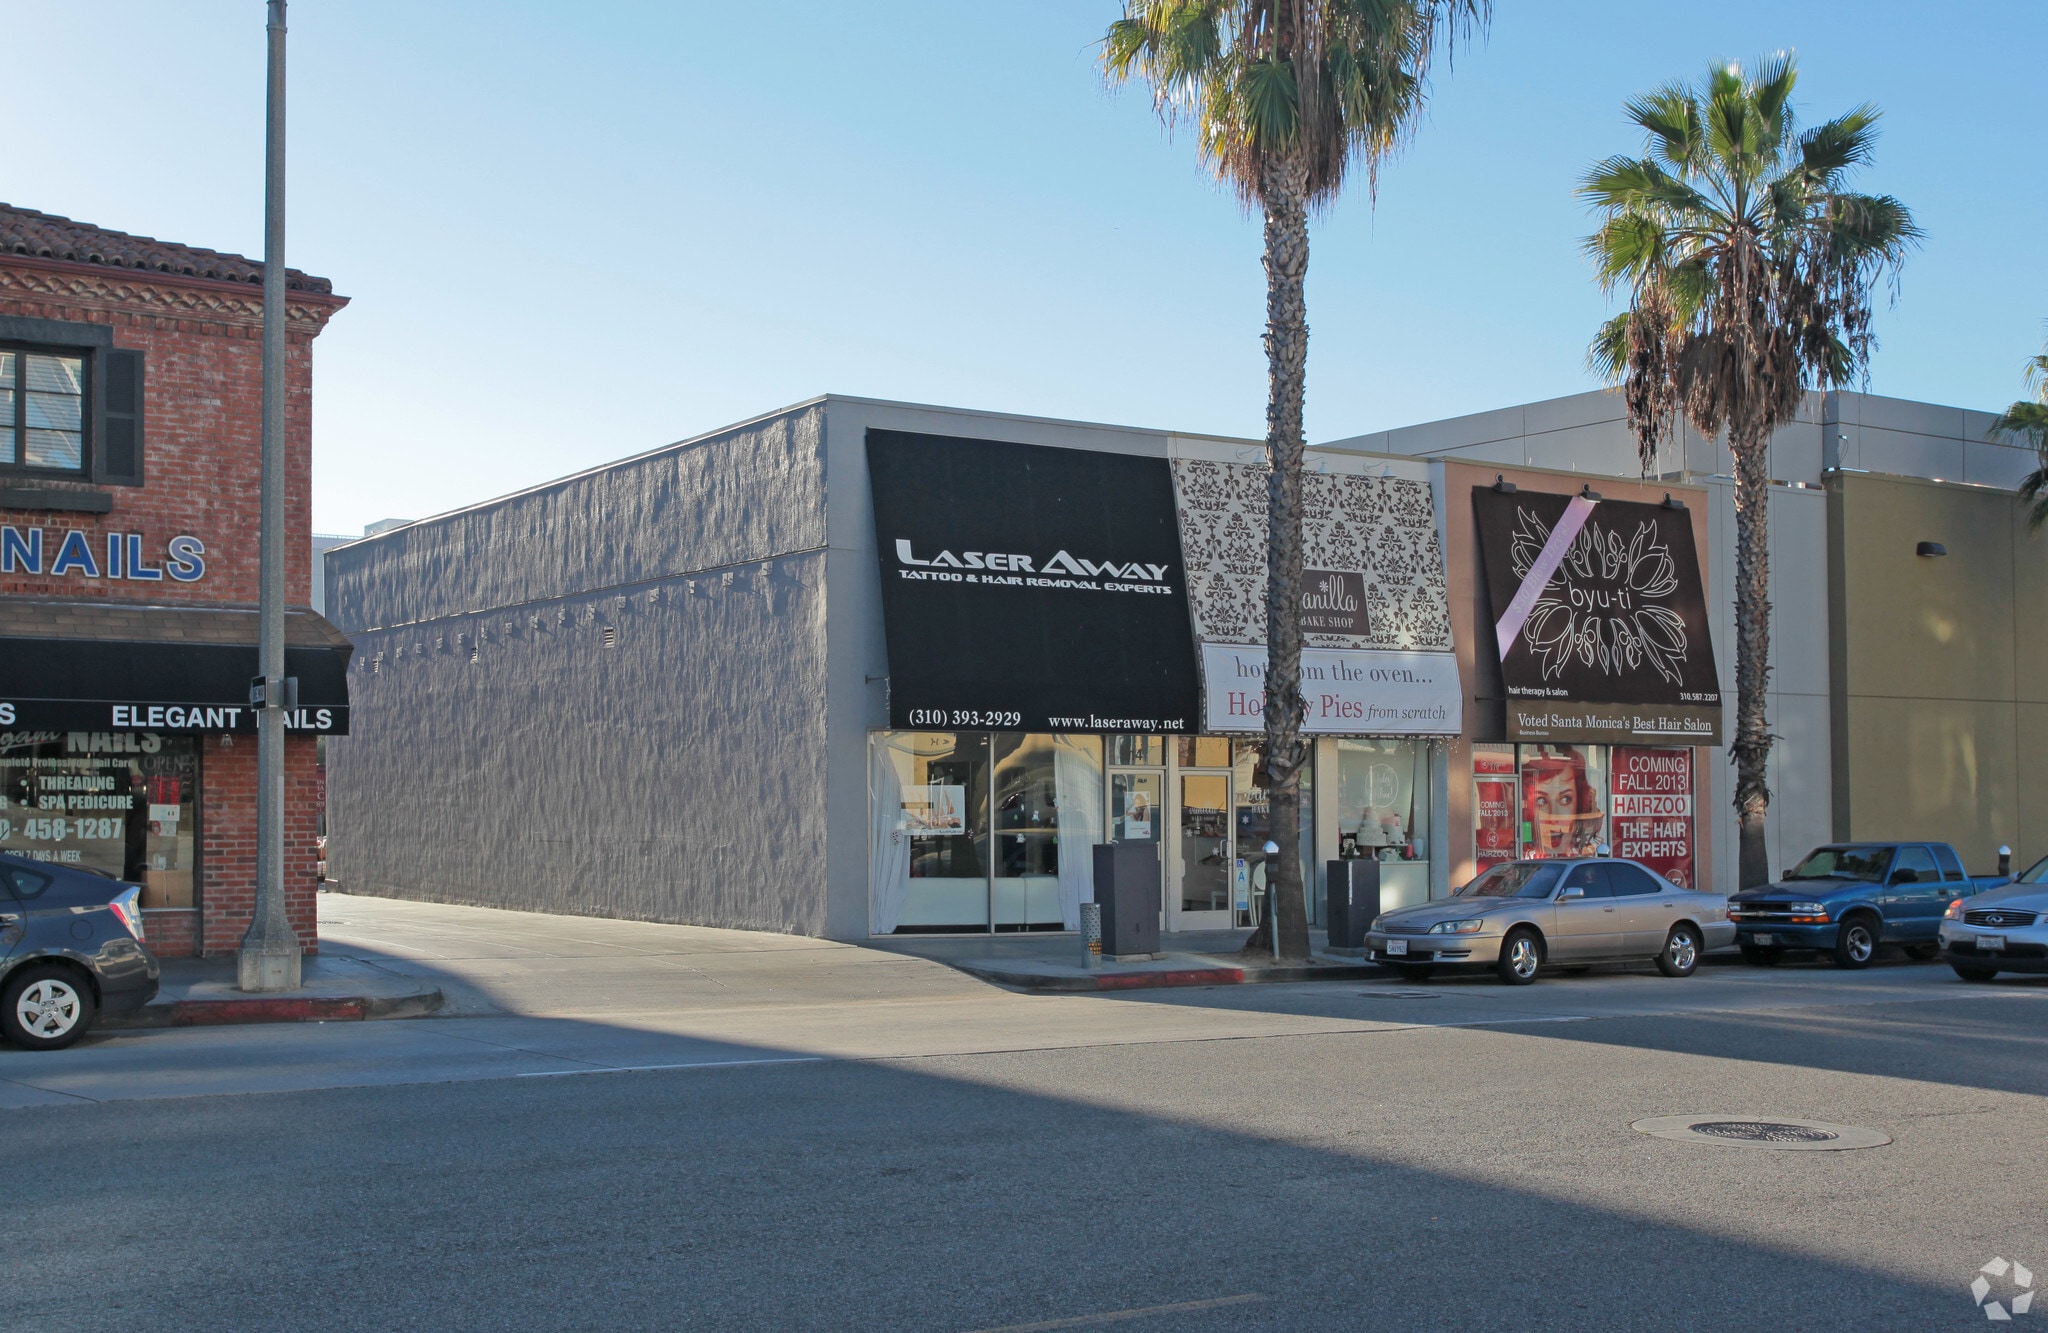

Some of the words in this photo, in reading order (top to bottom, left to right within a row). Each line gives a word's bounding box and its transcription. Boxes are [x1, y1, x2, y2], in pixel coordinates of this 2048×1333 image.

[1, 526, 206, 583] NAILS
[898, 570, 963, 582] TATTOO
[966, 573, 979, 583] &
[982, 575, 1024, 586] HAIR
[1026, 578, 1101, 590] REMOVAL
[1104, 582, 1172, 595] EXPERTS
[1302, 575, 1358, 612] anilla
[1569, 582, 1631, 613] byu-ti
[1328, 617, 1354, 629] SHOP
[1330, 660, 1363, 682] the
[1369, 667, 1433, 684] oven...
[1508, 686, 1521, 695] hair
[1521, 686, 1546, 697] therapy
[1546, 687, 1551, 696] &
[1552, 688, 1569, 697] salon
[1320, 693, 1363, 718] Pies
[1366, 703, 1399, 722] from
[1401, 703, 1446, 720] scratch
[112, 705, 241, 728] ELEGANT
[909, 709, 948, 727] (310)
[952, 710, 1021, 726] 393-2929
[1048, 715, 1185, 731] www.laseraway.net
[1517, 713, 1548, 727] Voted
[1551, 714, 1582, 728] Santa
[1585, 715, 1630, 729] Monica's
[1633, 716, 1655, 730] Best
[1658, 717, 1682, 730] Hair
[1684, 717, 1712, 731] Salon
[67, 732, 162, 753] NAILS
[93, 758, 110, 767] Nail
[1629, 756, 1685, 773] COMING
[40, 776, 115, 790] THREADING
[1619, 774, 1652, 790] FALL
[1655, 775, 1686, 790] 2013
[39, 796, 65, 809] SPA
[68, 796, 133, 809] PEDICURE
[1614, 797, 1686, 814] HAIRZOO
[24, 818, 122, 839] 458-1287
[1620, 822, 1649, 838] THE
[1653, 822, 1686, 838] HAIR
[33, 850, 51, 861] DAYS
[53, 850, 59, 862] A
[61, 850, 81, 862] WEEK
[1479, 849, 1509, 858] HAIRZOO
[1621, 841, 1687, 858] EXPERTS
[1238, 870, 1246, 882] A
